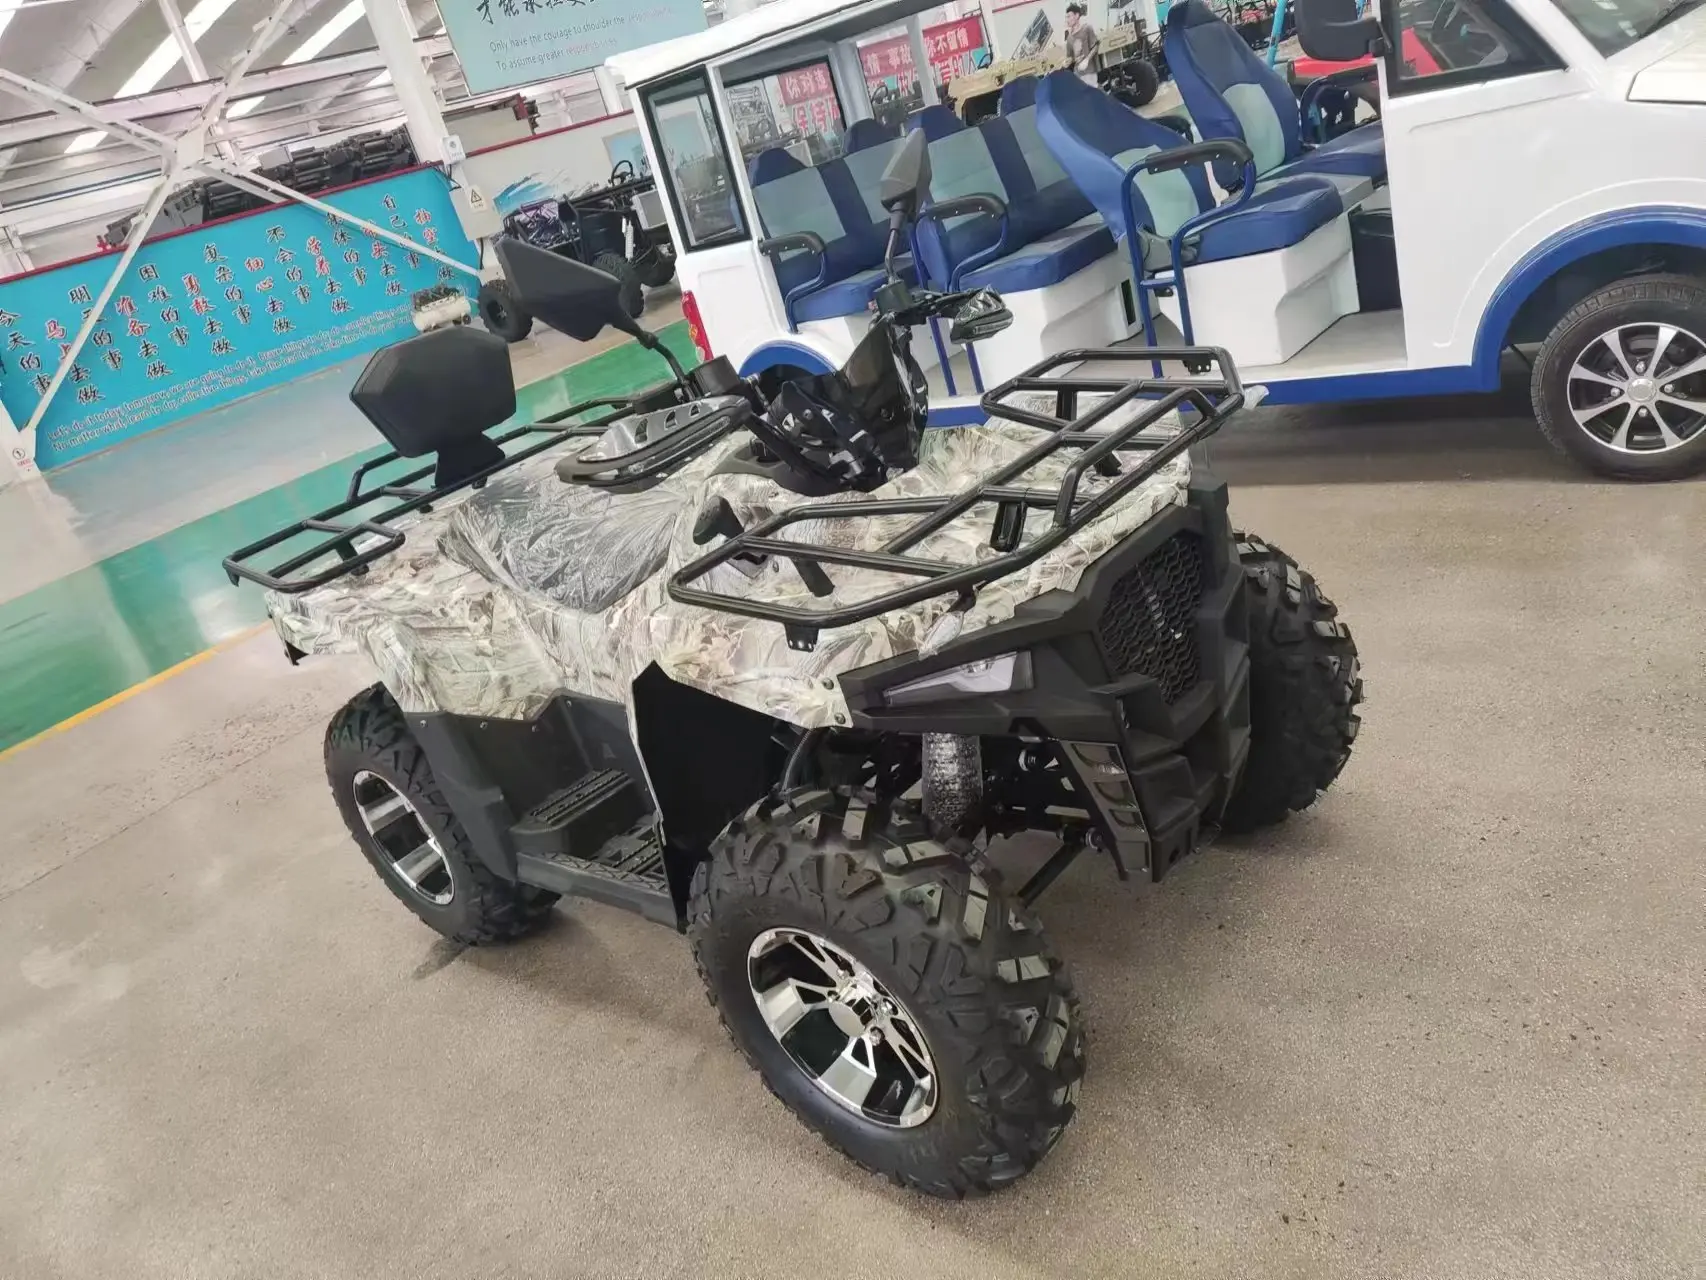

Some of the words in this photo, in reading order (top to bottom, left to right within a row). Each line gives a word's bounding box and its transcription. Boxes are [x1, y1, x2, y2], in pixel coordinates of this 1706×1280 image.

[489, 40, 508, 53] Only
[509, 36, 527, 46] have
[529, 32, 541, 43] the
[543, 27, 572, 41] courage
[573, 25, 581, 33] to
[582, 17, 612, 31] shoulder
[613, 15, 624, 24] the
[496, 59, 506, 70] To
[508, 55, 536, 67] assume
[538, 48, 564, 63] greater
